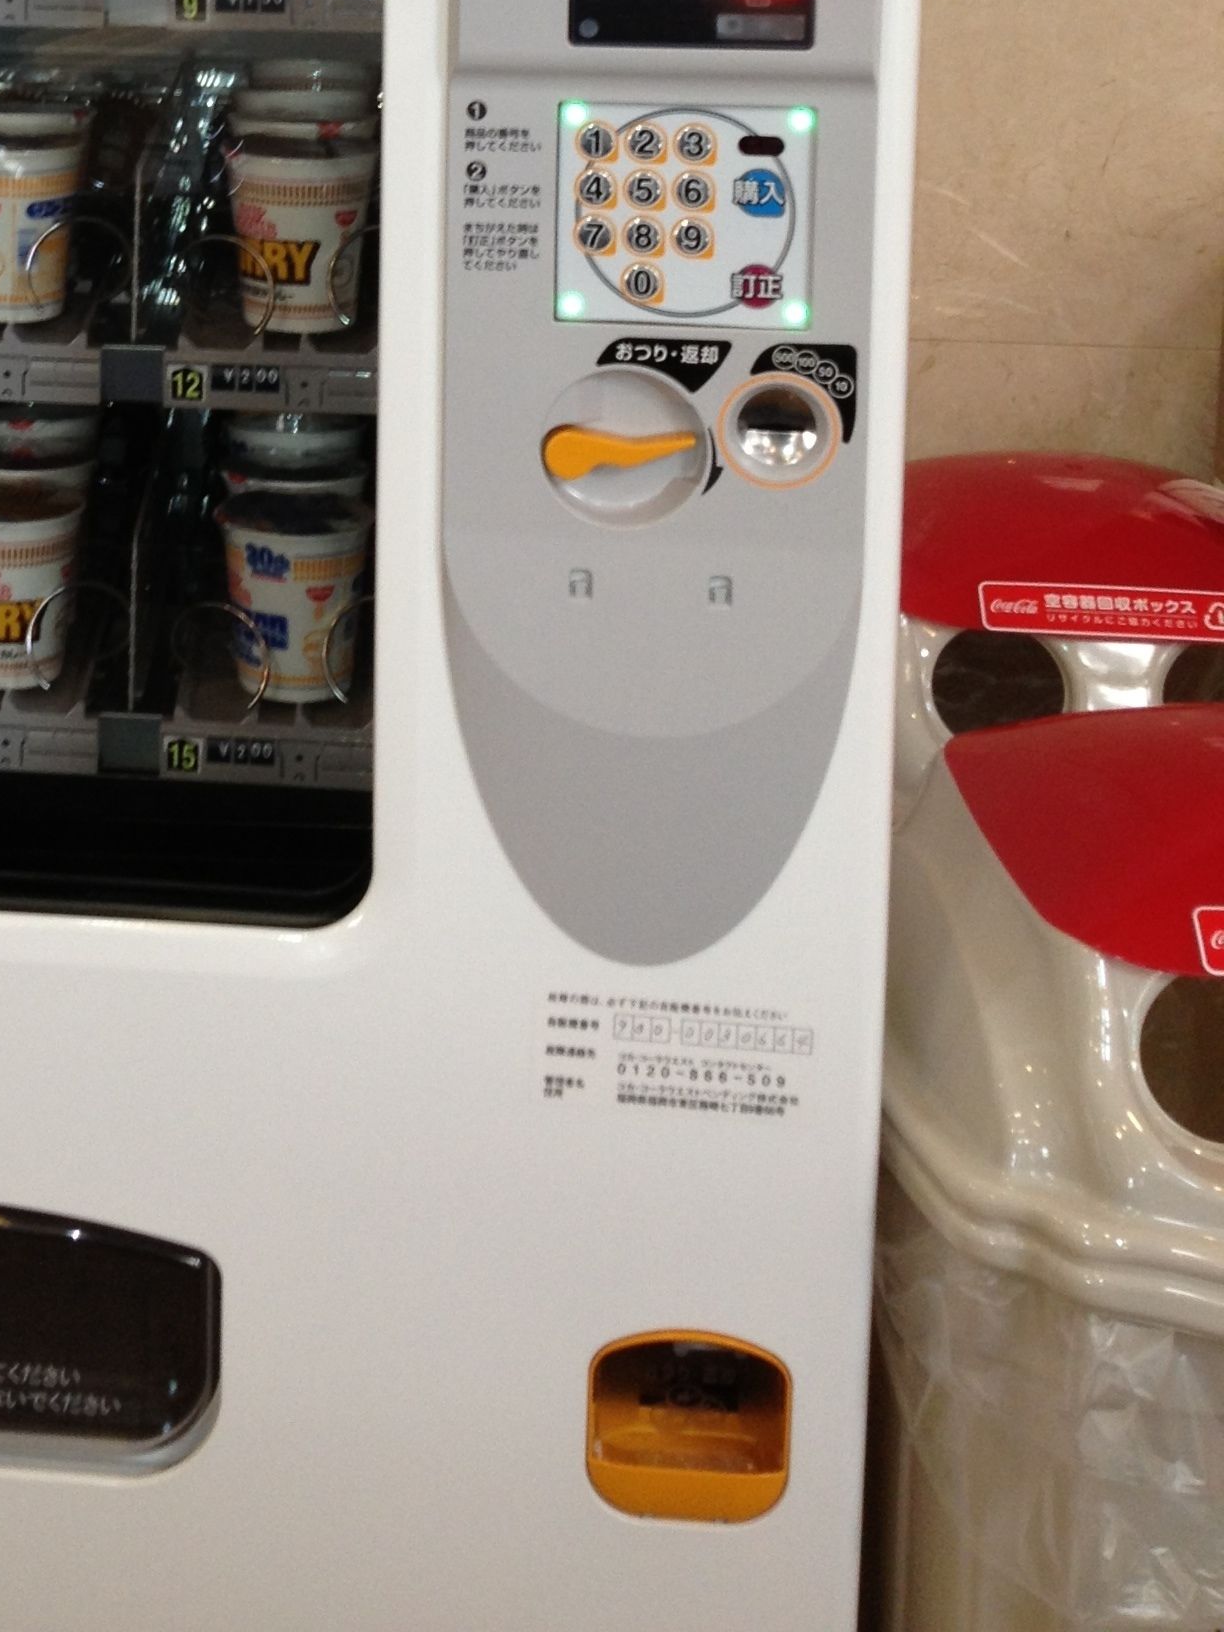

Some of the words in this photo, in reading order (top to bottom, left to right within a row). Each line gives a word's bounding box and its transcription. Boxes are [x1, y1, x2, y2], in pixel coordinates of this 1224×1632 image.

[464, 141, 542, 153] 押してください
[591, 129, 601, 155] 1
[635, 129, 654, 155] 2
[685, 131, 704, 157] 3
[585, 174, 603, 200] 4
[635, 177, 653, 203] 5
[683, 178, 702, 204] 6
[731, 177, 786, 207] 購入
[463, 197, 541, 209] 押してください
[584, 222, 604, 250] 7
[634, 223, 652, 250] 8
[683, 225, 702, 252] 9
[463, 260, 518, 272] てください
[633, 270, 651, 296] 0
[730, 272, 785, 301] 訂正
[613, 341, 720, 366] おつり・返却
[171, 370, 202, 400] 12
[223, 367, 279, 385] ¥200
[989, 598, 1039, 615] Coca-Cola
[1043, 593, 1197, 615] 空容器回収ボックス
[167, 741, 198, 772] 15
[217, 741, 273, 760] ¥200
